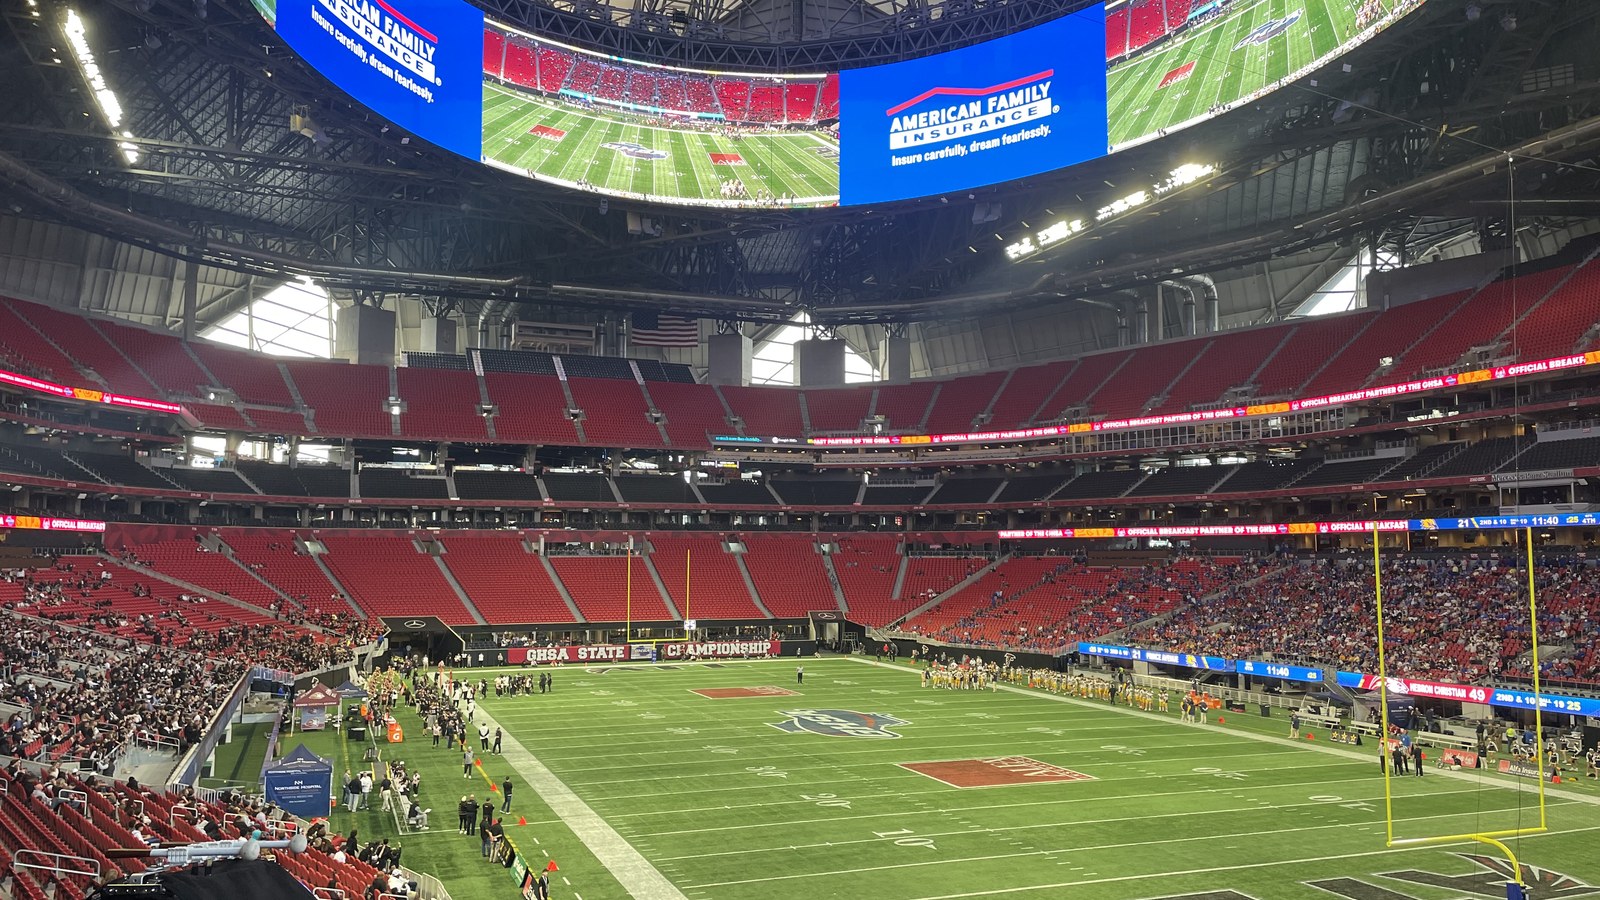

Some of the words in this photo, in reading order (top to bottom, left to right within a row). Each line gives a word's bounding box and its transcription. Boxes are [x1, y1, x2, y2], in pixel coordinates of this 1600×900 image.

[328, 0, 423, 73] NSURANCE
[385, 15, 435, 62] FAMILY
[312, 5, 334, 36] Insure
[335, 30, 368, 64] carefully,
[370, 54, 393, 79] dream
[394, 70, 434, 103] fearlessly.
[890, 100, 982, 132] AMERICAN
[988, 81, 1051, 113] FAMILY
[904, 106, 1038, 144] INSURANCE
[892, 153, 922, 167] Insure
[924, 144, 968, 162] carefully,
[970, 136, 1000, 153] dream
[1002, 124, 1051, 145] fearlessly.
[1508, 362, 1548, 375] OFFICIAL
[1301, 397, 1328, 407] OFFICIAL
[1329, 391, 1365, 404] BREAKFAST
[1366, 387, 1396, 398] PARTNER
[1398, 384, 1407, 392] OF
[1409, 382, 1421, 391] THE
[1423, 379, 1443, 389] GHSA
[1103, 420, 1128, 429] OFFICIAL
[1130, 416, 1163, 426] BREAKFAST
[1164, 414, 1192, 423] PARTNER
[1202, 412, 1213, 420] THE
[1216, 410, 1234, 418] GHSA
[942, 434, 966, 442] OFFICIAL
[968, 432, 1000, 440] BREAKFAST
[52, 520, 76, 529] OFFICIAL
[77, 522, 106, 531] BREAKFAST
[1331, 522, 1364, 531] OFFICIAL
[1458, 519, 1469, 528] 21
[1532, 516, 1558, 526] 11:40
[1128, 528, 1158, 536] OFFICIAL
[1159, 527, 1199, 535] BREAKFAST
[1200, 526, 1233, 534] PARTNER
[527, 648, 569, 663] GHSA
[578, 646, 625, 660] STATE
[1132, 650, 1140, 659] 21
[1267, 666, 1289, 677] 11:40
[1410, 683, 1433, 695] HEBRON
[1434, 685, 1466, 698] CHRISTIAN
[1469, 689, 1486, 701] 49
[1496, 694, 1514, 702] 2ND
[1525, 697, 1536, 705] 10
[1554, 700, 1564, 708] 19
[1566, 701, 1581, 711] 25
[1510, 765, 1521, 773] Alfa
[1522, 766, 1552, 778] Insurace
[800, 793, 851, 808] 20
[873, 828, 935, 849] 10
